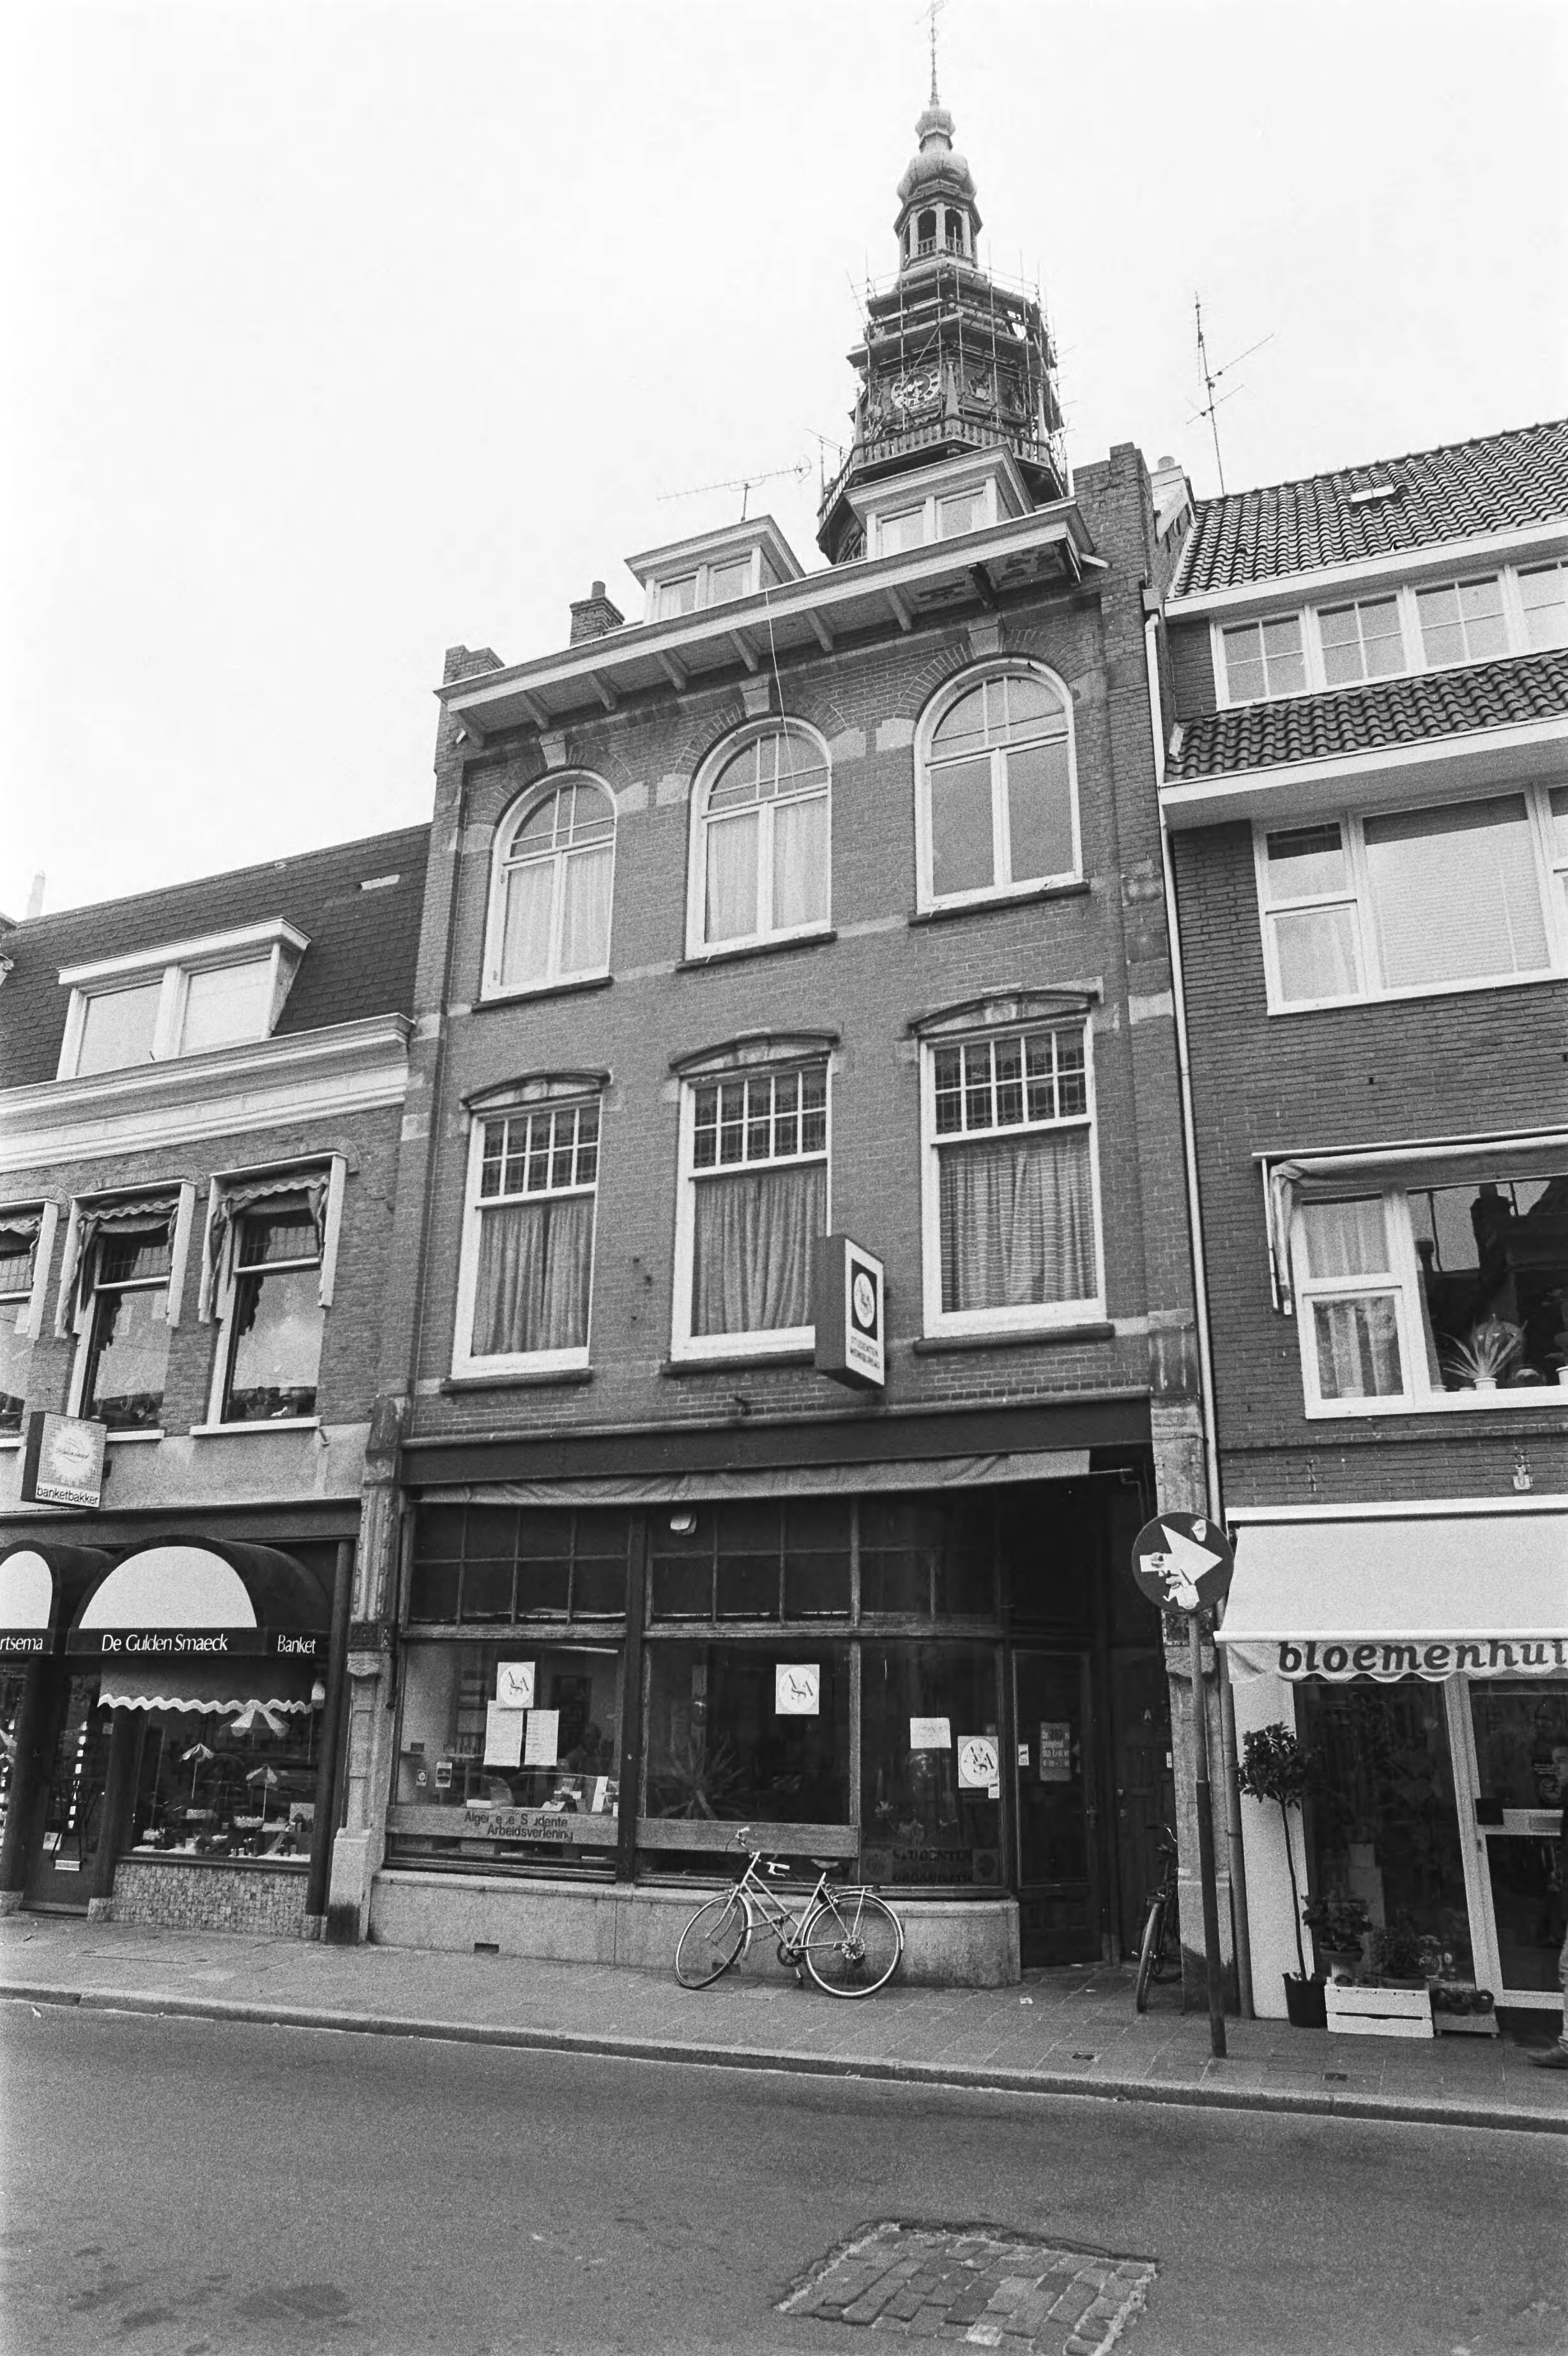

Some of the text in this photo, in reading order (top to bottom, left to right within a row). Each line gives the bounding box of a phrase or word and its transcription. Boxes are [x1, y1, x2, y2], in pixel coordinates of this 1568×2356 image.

[37, 1485, 98, 1504] banketbakker
[0, 1636, 43, 1650] rtsema
[102, 1633, 229, 1651] De Gulden Smaeck
[277, 1635, 316, 1654] Banket
[1278, 1639, 1567, 1672] bloemenhui
